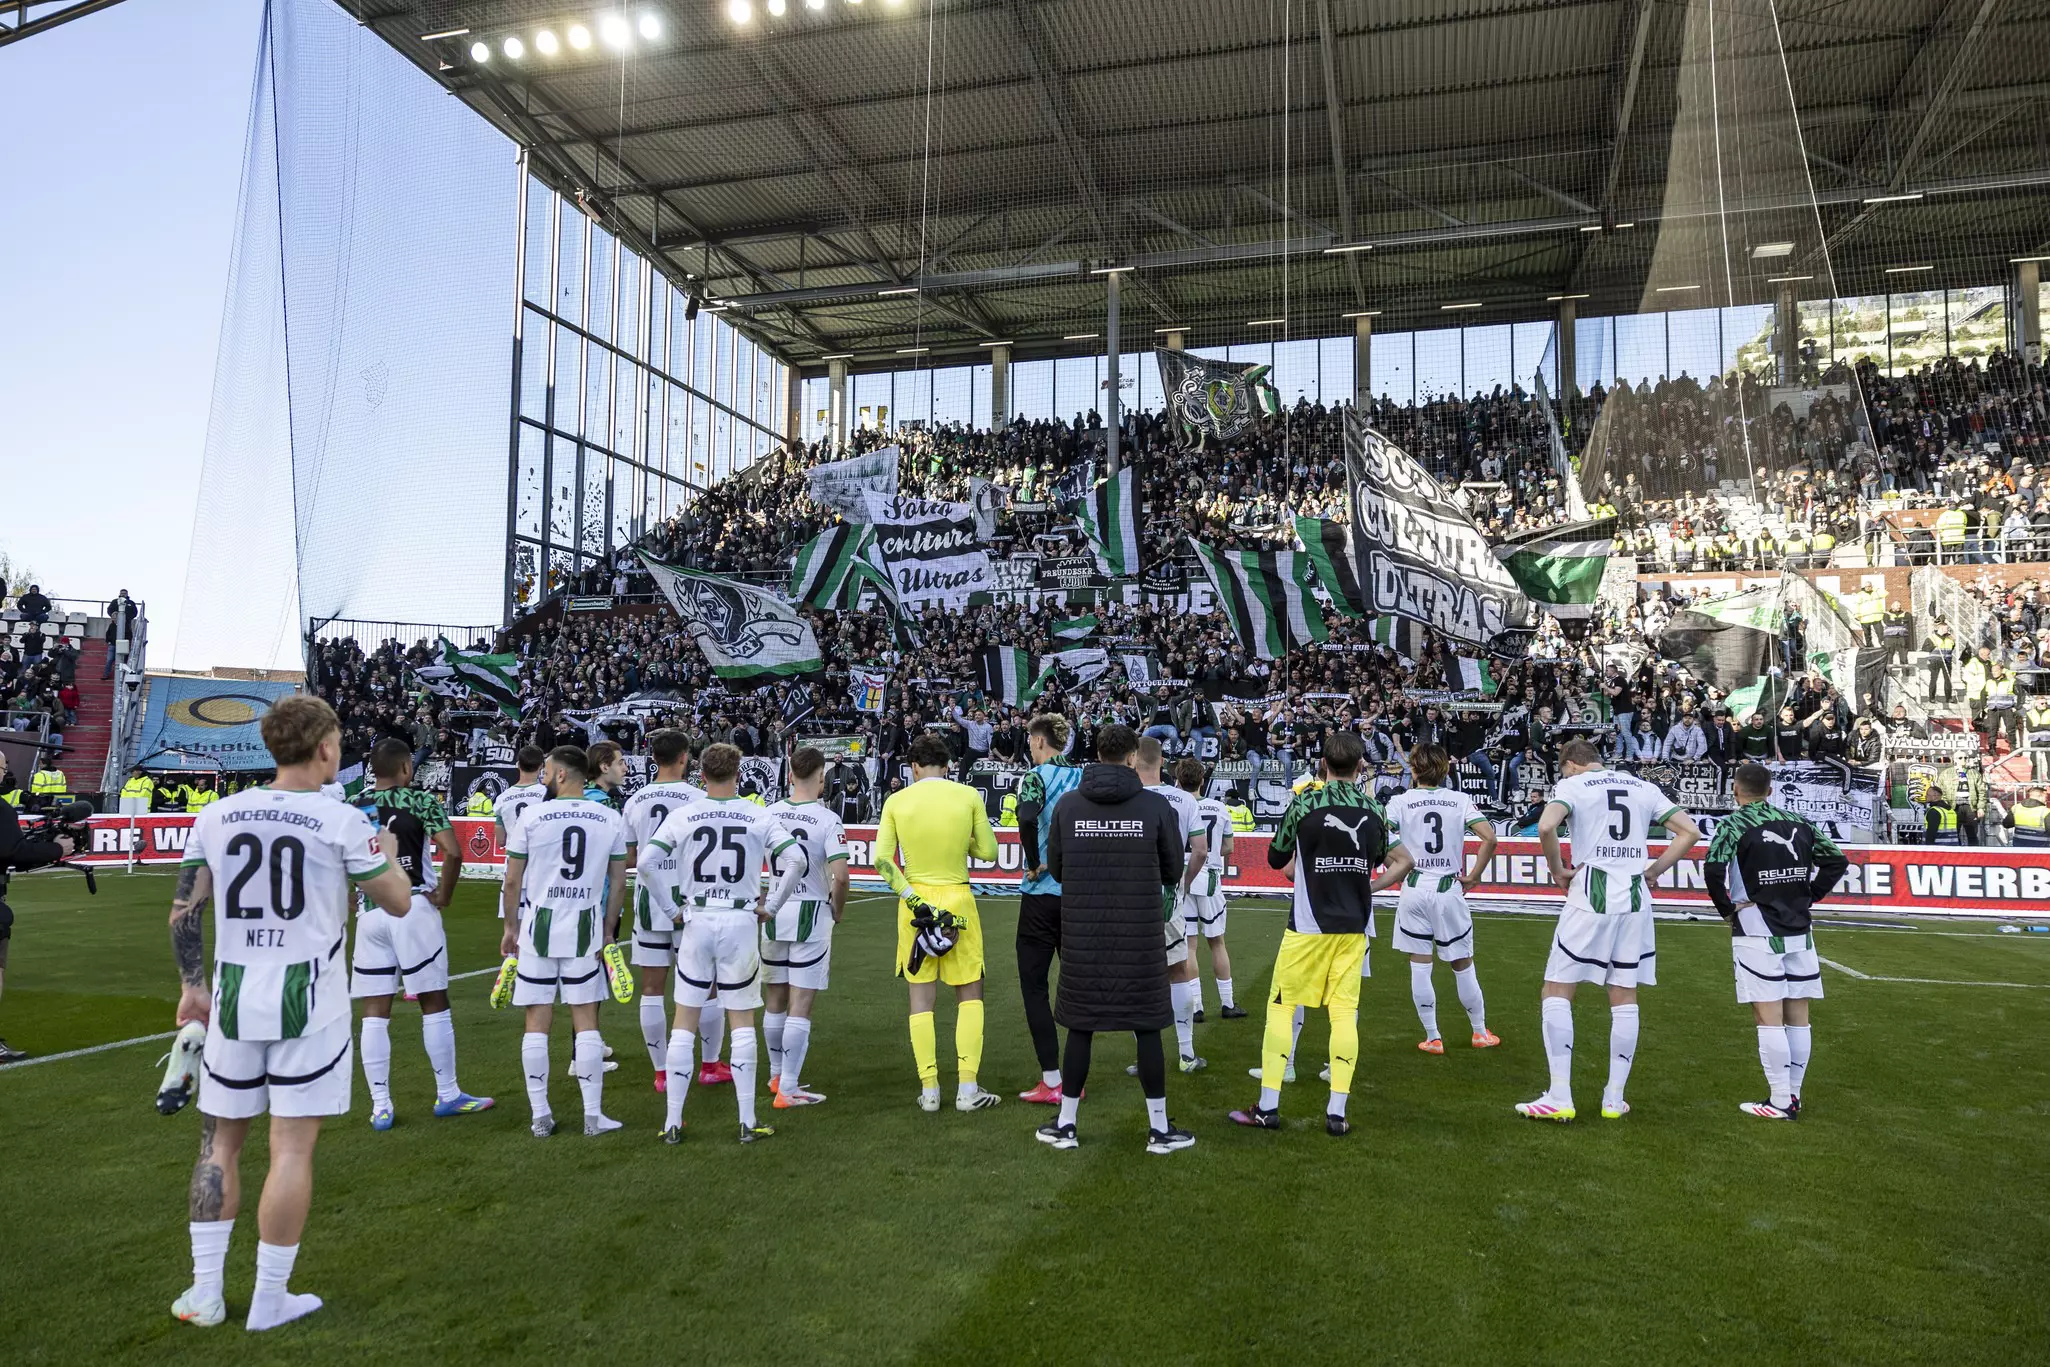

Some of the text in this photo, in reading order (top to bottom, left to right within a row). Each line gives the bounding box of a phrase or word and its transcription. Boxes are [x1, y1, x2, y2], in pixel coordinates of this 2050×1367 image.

[898, 567, 985, 595] Ultras
[1074, 820, 1143, 829] REUTER
[1606, 789, 1631, 841] 5
[1423, 811, 1444, 854] 3
[560, 825, 586, 880] 9
[693, 826, 747, 884] 25
[1417, 857, 1451, 868] ITAKURA
[1596, 846, 1642, 859] FRIEDRICH
[226, 832, 305, 921] 20
[547, 886, 592, 899] HONORAT
[705, 888, 731, 900] HACK
[246, 929, 284, 947] NETZ
